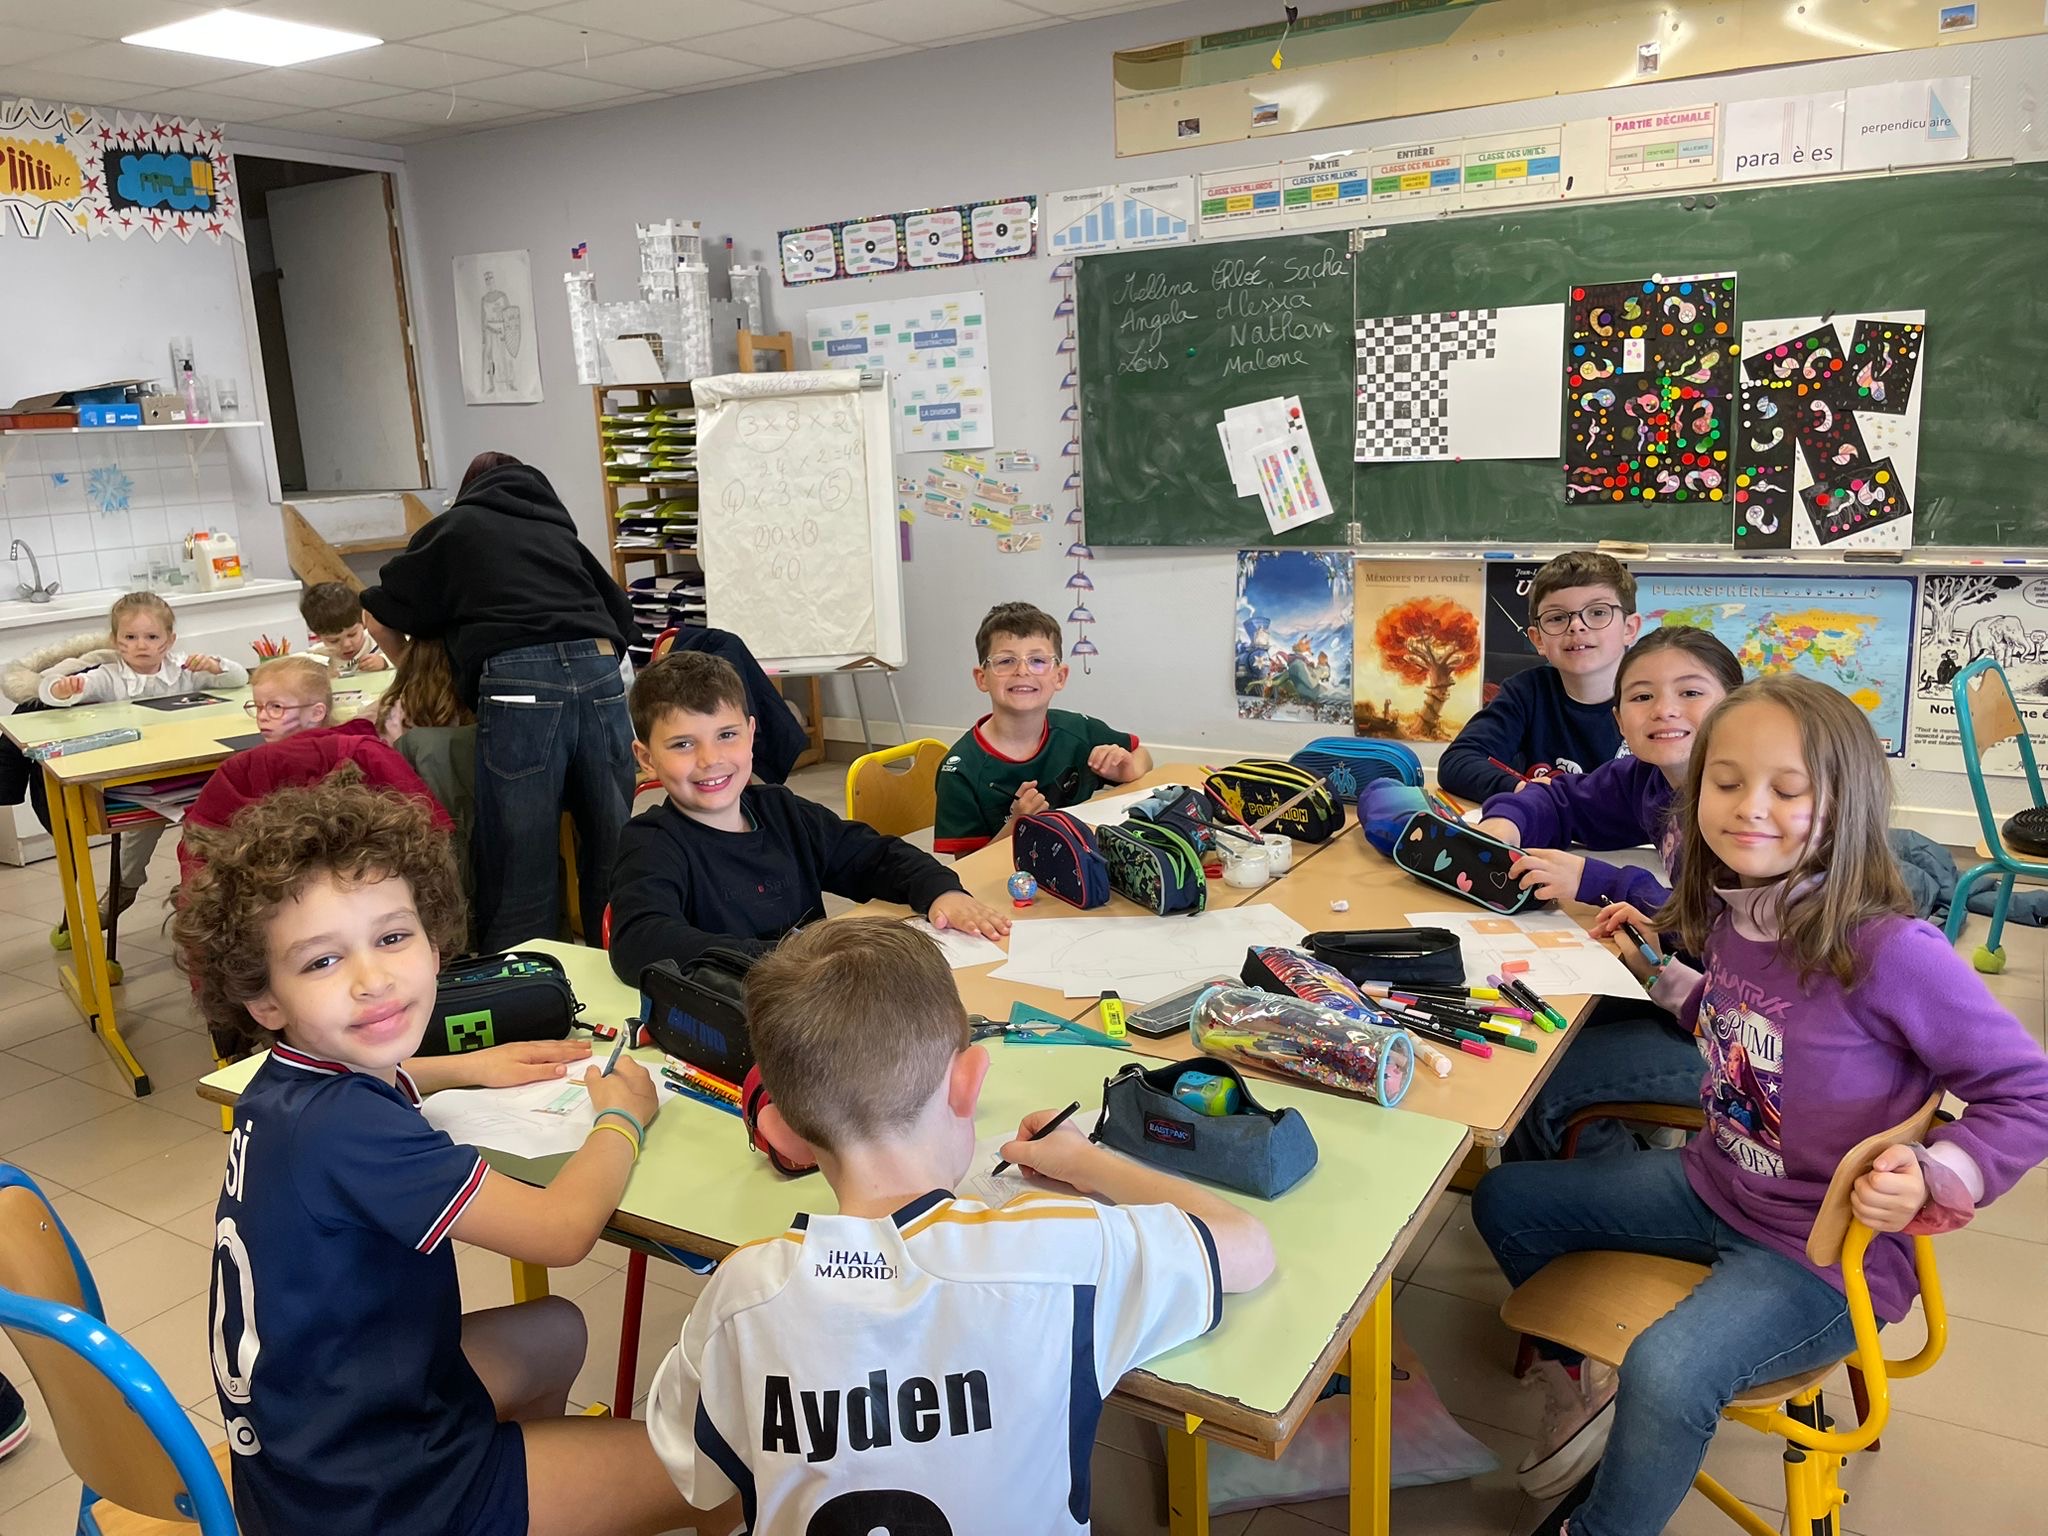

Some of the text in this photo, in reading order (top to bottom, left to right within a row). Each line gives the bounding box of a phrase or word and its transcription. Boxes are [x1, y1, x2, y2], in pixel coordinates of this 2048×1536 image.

[1615, 111, 1711, 132] PARTIE DÉCIMALE
[1397, 145, 1435, 160] ENTIÈRE
[1478, 152, 1505, 162] CLASSE
[1506, 149, 1521, 159] DES
[1309, 159, 1340, 171] PARTIE
[1381, 165, 1406, 174] CLASSE
[1407, 162, 1420, 171] DES
[1292, 170, 1358, 186] CLASSE DES MILLIONS
[1207, 188, 1229, 196] CLASSE
[1230, 310, 1332, 348] Nathan
[1413, 575, 1425, 583] DE
[1428, 575, 1439, 583] LA
[1716, 1007, 1776, 1072] RUMI
[1149, 1122, 1187, 1140] EASTPAK
[815, 1264, 898, 1280] MADRID!
[762, 1368, 993, 1463] Ayden
